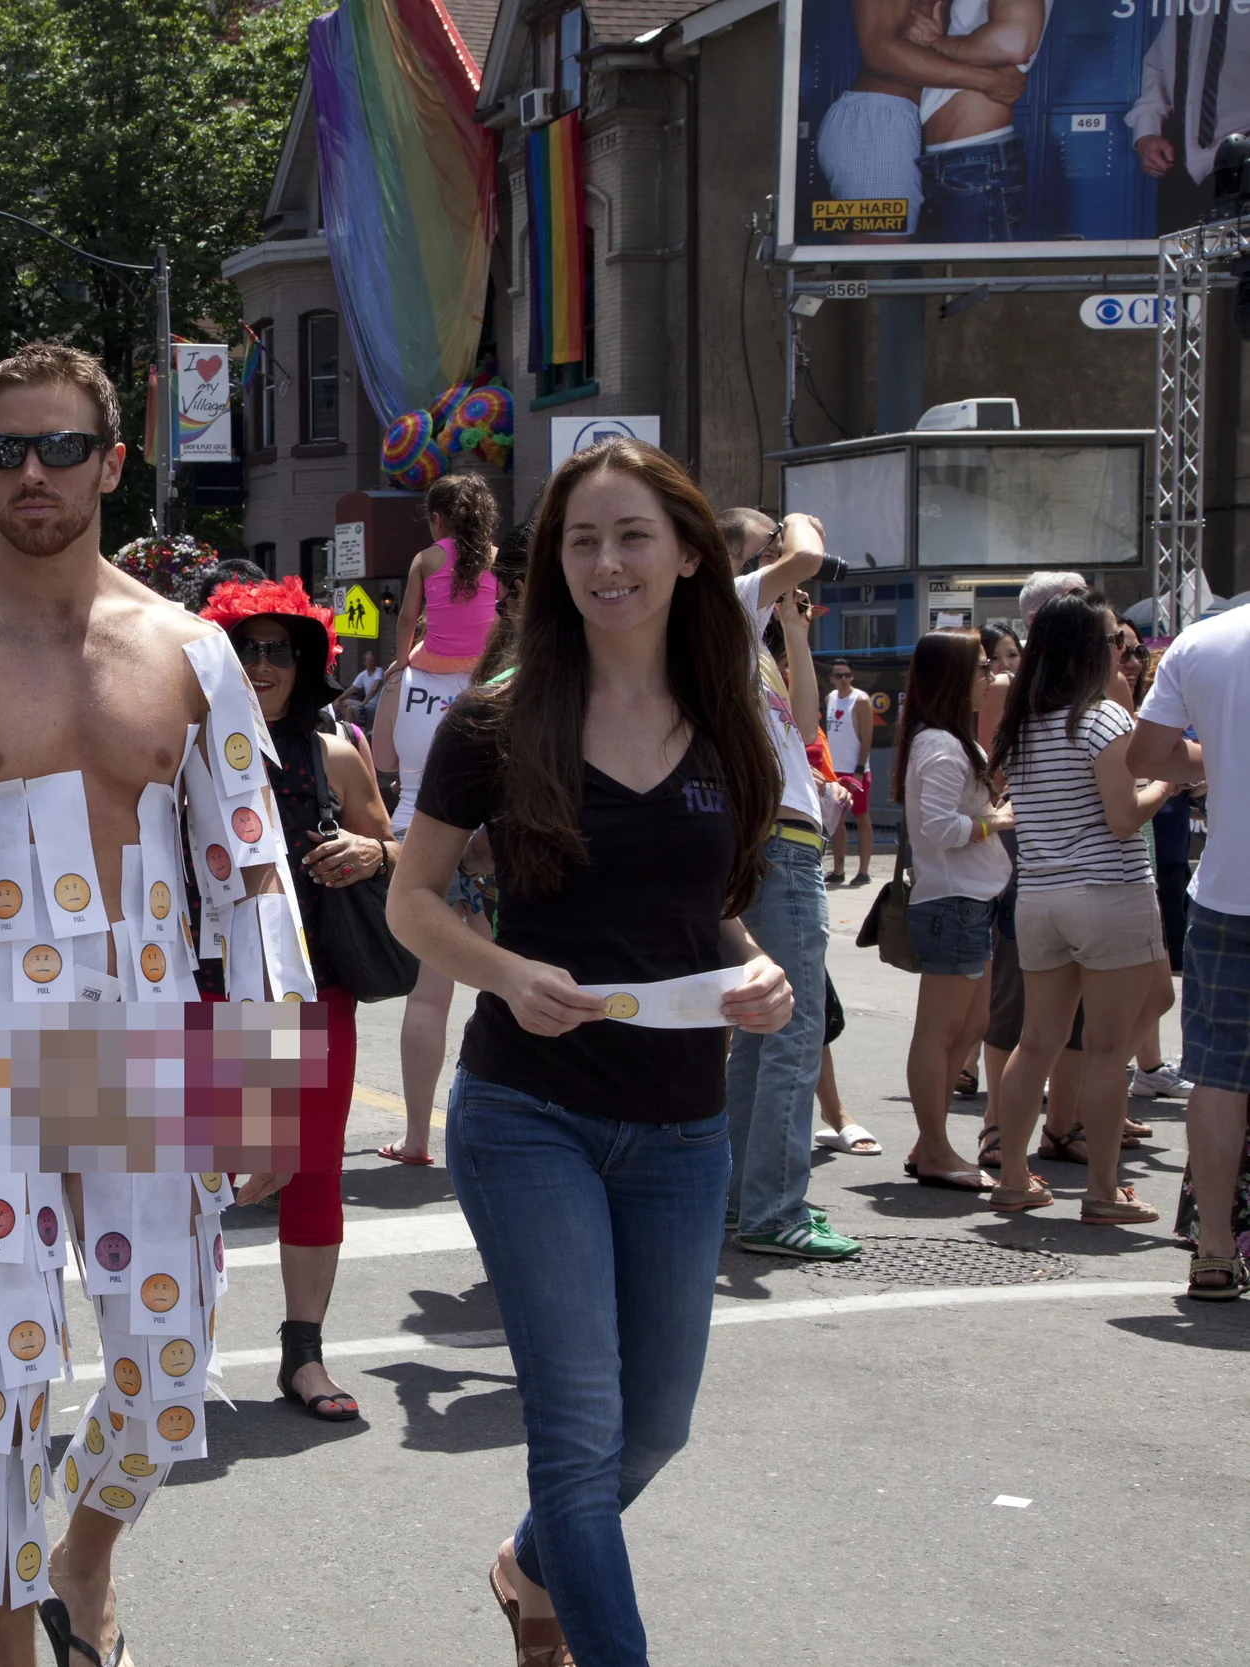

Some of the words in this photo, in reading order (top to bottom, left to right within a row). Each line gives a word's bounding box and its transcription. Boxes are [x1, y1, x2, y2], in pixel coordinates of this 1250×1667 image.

[1151, 0, 1250, 17] more
[1077, 118, 1101, 128] 469
[815, 204, 854, 216] PLAY
[860, 202, 903, 215] HARD
[813, 219, 849, 231] PLAY
[853, 218, 904, 231] SMART
[826, 283, 867, 297] 8566
[1129, 298, 1180, 325] CB
[183, 352, 200, 371] I
[197, 382, 220, 395] my
[182, 391, 226, 417] Village
[931, 582, 947, 591] PAY
[241, 774, 250, 782] PULL
[692, 780, 722, 791] WAXB
[249, 847, 260, 855] PULL
[1, 923, 12, 931] PULL
[26, 1364, 37, 1373] PULL
